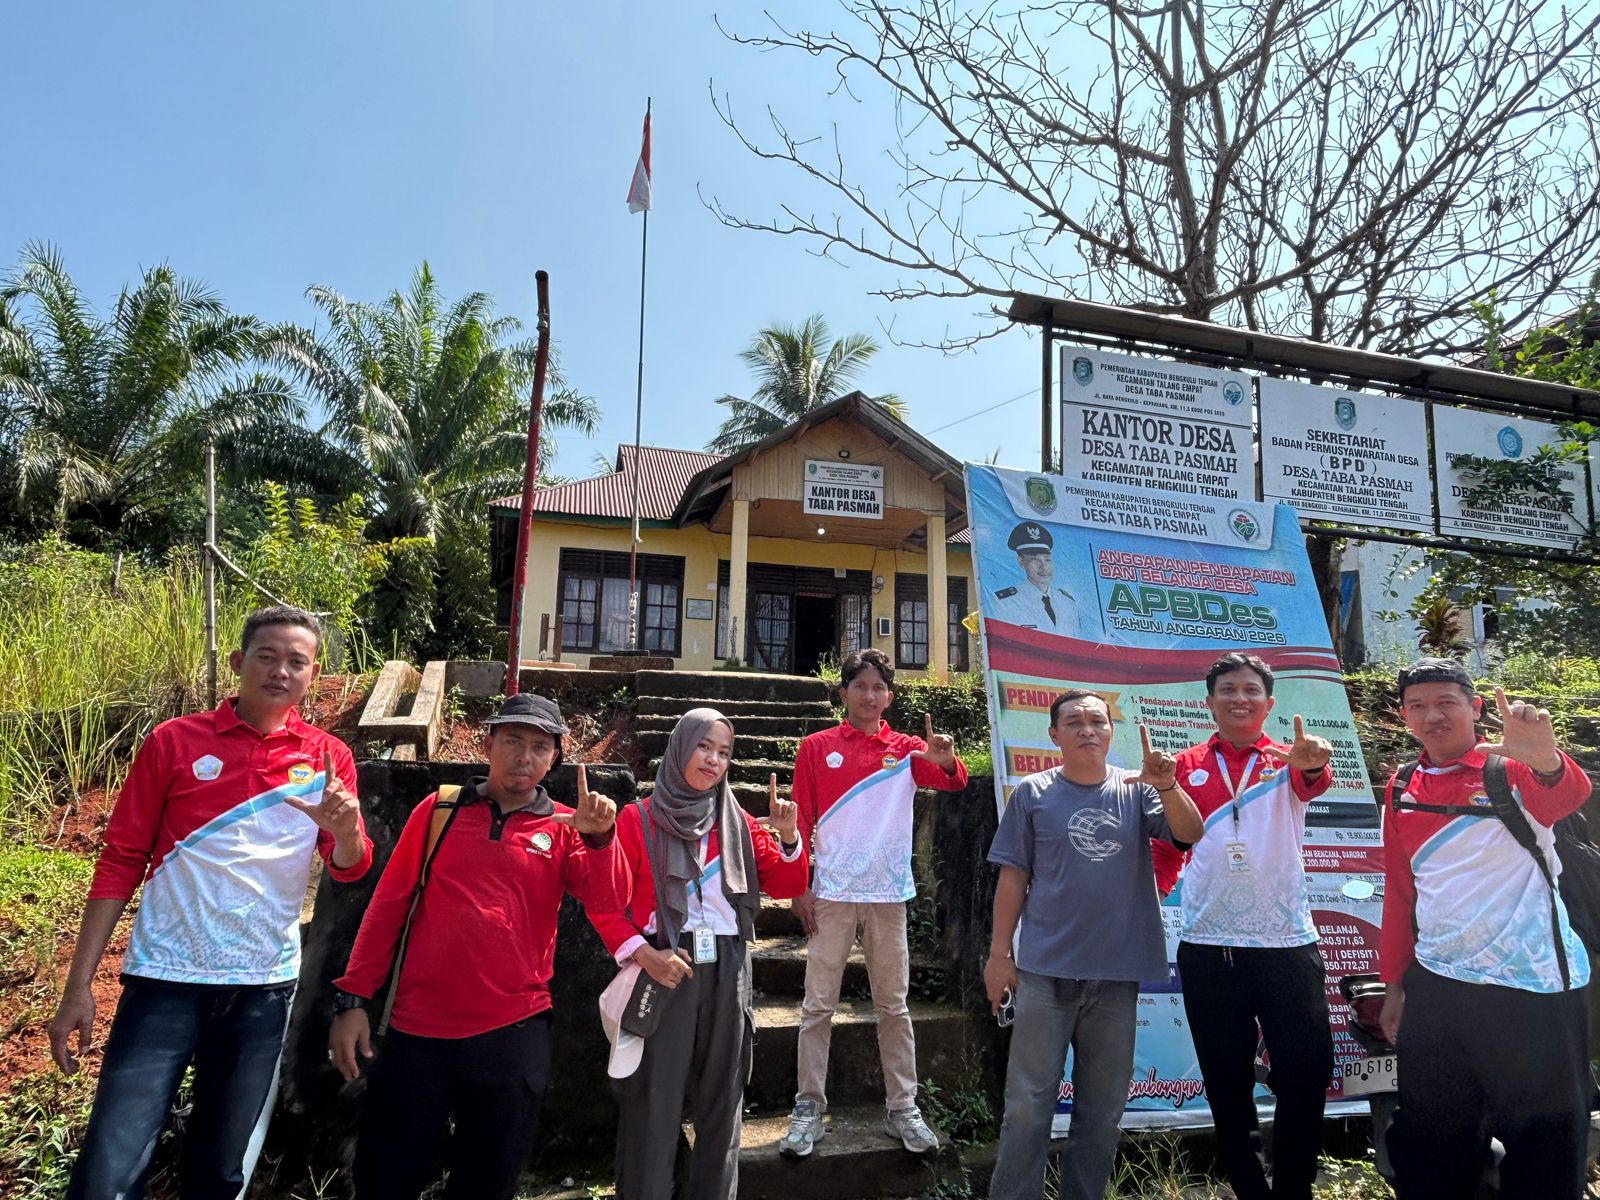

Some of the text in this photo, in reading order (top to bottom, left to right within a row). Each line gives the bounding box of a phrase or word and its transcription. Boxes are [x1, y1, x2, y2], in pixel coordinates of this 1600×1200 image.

[1100, 363, 1218, 388] PEMERINTAH KABUPATEN BENGKULU TENGAH
[1116, 374, 1203, 394] KECAMATAN TALANG EMPAT
[1125, 385, 1195, 402] DESA TABA PASMAH
[1081, 409, 1237, 454] KANTOR DESA
[1307, 429, 1386, 450] SEKRETARIAT
[1081, 438, 1238, 474] DESA TABA PASMAH
[1271, 436, 1420, 467] BADAN PERMUSYAWARATAN DESA
[1091, 459, 1230, 487] KECAMATAN TALANG EMPAT
[1282, 464, 1414, 492] DESA TABA PASMAH
[811, 485, 876, 501] KANTOR DESA
[1065, 485, 1216, 515] PEMERINTAH KABUPATEN BENGKULU TENGAH
[1144, 479, 1197, 494] BENGKULU
[1199, 486, 1238, 500] TENGAH
[1291, 488, 1408, 510] KABUPATEN BENGKULU TENGAH
[1298, 479, 1401, 500] KECAMATAN TALANG EMPAT
[807, 498, 880, 514] TABA PASMAH
[1084, 497, 1200, 521] KECAMATAN TALANG EMPAT
[1511, 507, 1537, 518] TALANG
[1539, 512, 1561, 521] EMPAT
[1081, 507, 1208, 537] DESA TABA PASMAH
[1461, 509, 1569, 532] KABUPATEN BENGKULU TENGAH
[1098, 549, 1296, 586] ANGGARAN PENDAPATAN
[1099, 563, 1258, 596] DAN BELANJA DESA
[1106, 582, 1277, 630] APBDes
[1108, 616, 1287, 645] TAHUN ANGGARAN 2026
[1131, 695, 1138, 704] 1.
[1139, 696, 1183, 708] Pendapatan
[1184, 700, 1198, 708] Asli
[1133, 716, 1141, 725] 2.
[1142, 716, 1187, 729] Pendapatan
[1140, 706, 1209, 720] Bagi Hasil Bumdes
[1278, 716, 1350, 729] Rp. 2.812.000,00
[1149, 728, 1189, 739] Dana Desa
[1151, 738, 1168, 750] Bagi
[1169, 740, 1188, 750] Hasil
[1330, 760, 1360, 770] 2.720,00
[1313, 849, 1342, 859] BENCANA,
[1341, 851, 1367, 859] DARURAT
[1320, 925, 1360, 935] BELANJA
[1316, 936, 1365, 947] .240.971,63
[1340, 949, 1373, 959] DEFISIT
[1345, 1062, 1361, 1078] BD
